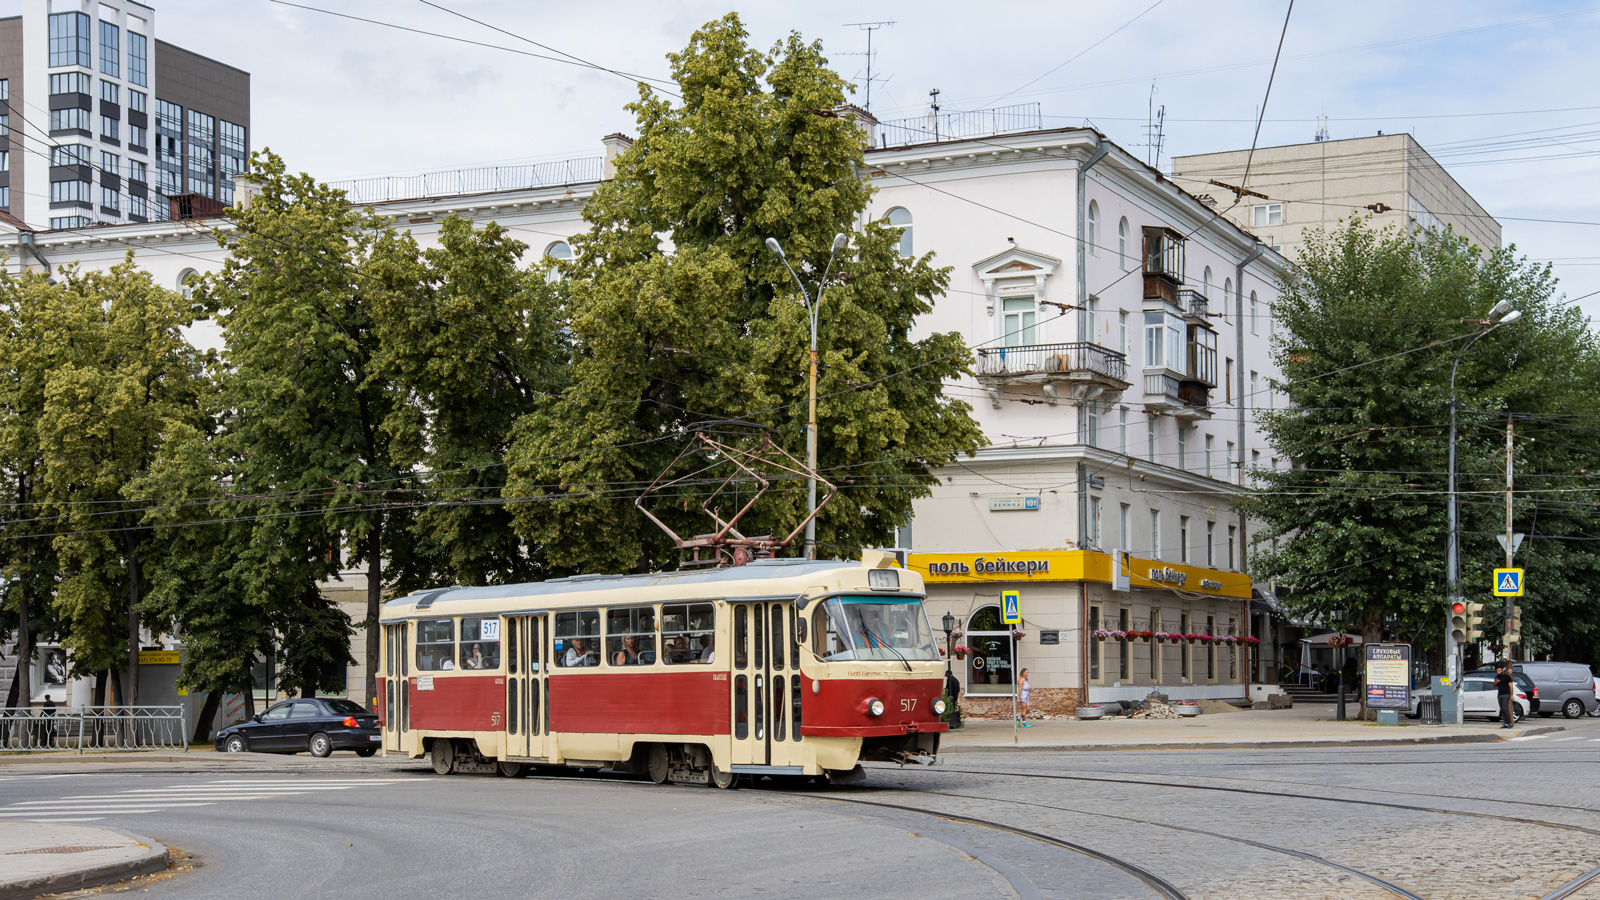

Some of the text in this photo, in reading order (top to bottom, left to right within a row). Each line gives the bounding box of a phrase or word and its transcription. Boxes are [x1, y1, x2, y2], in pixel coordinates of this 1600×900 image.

[1026, 499, 1037, 507] 101
[929, 557, 1049, 576] поль бейкери
[871, 571, 890, 587] 15
[1149, 568, 1164, 581] поль
[484, 622, 497, 634] 517
[900, 698, 917, 712] 517
[491, 715, 501, 727] 517
